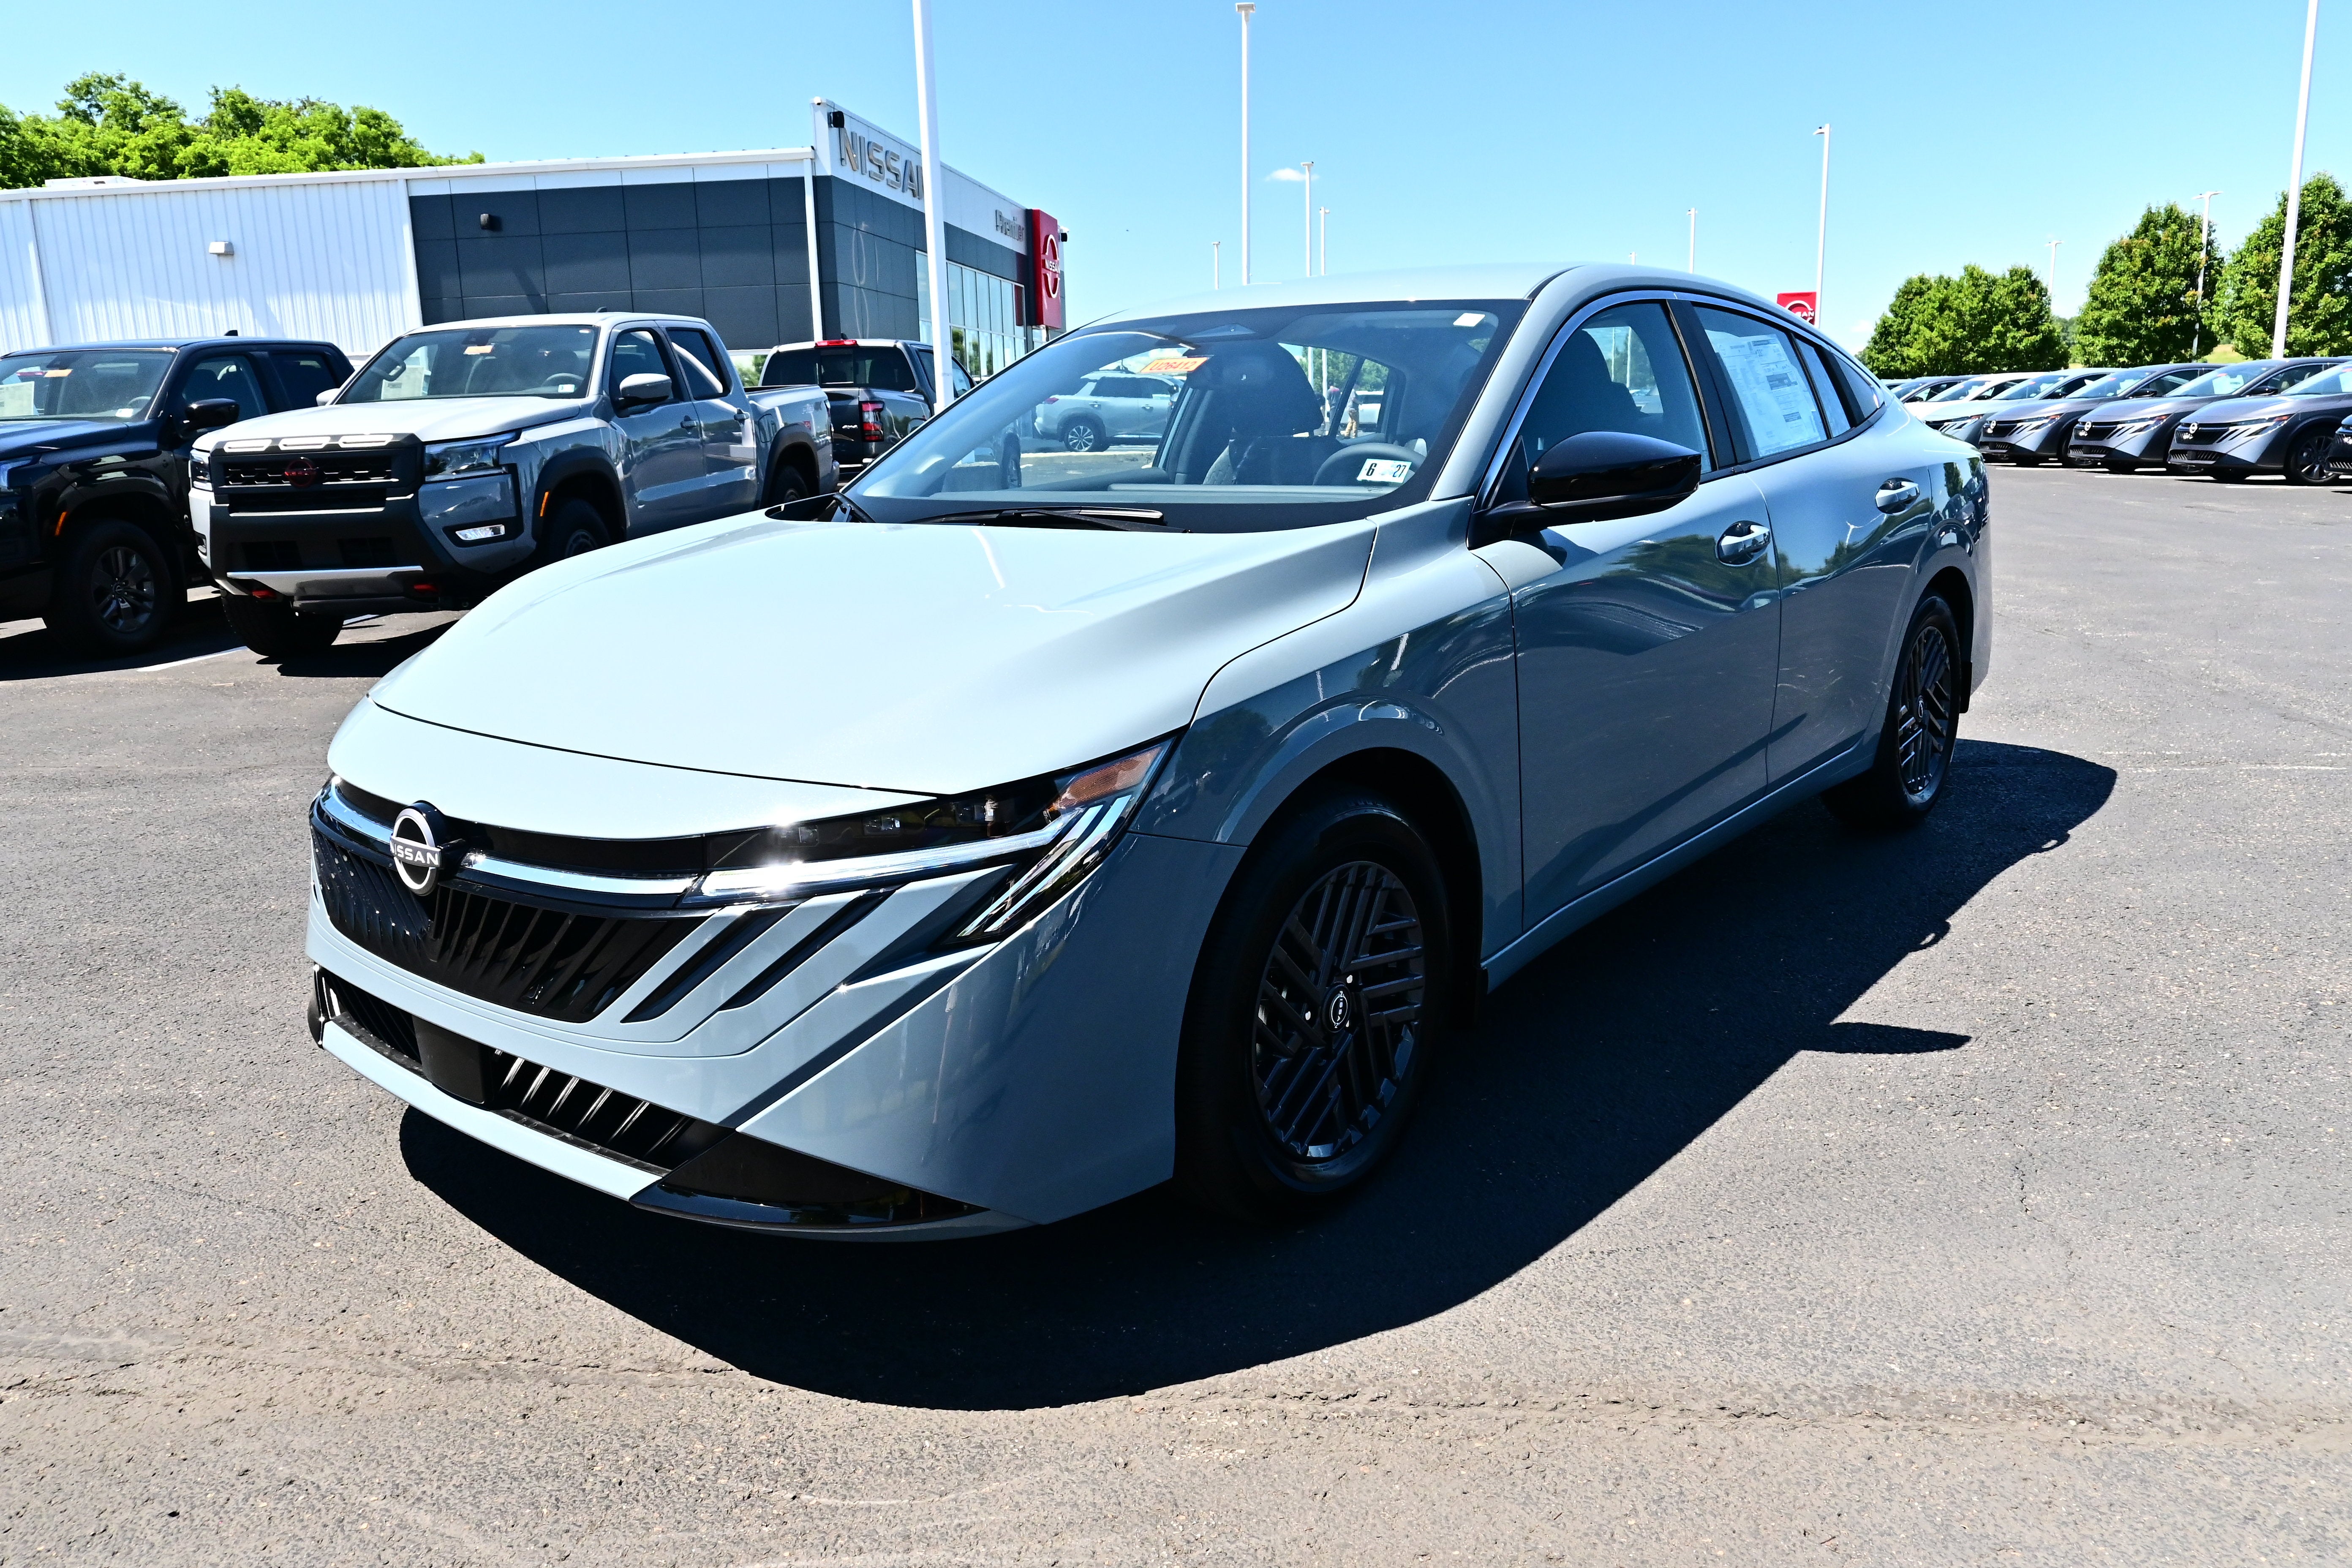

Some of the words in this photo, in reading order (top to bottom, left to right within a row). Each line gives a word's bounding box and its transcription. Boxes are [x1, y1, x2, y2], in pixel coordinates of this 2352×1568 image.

[1045, 258, 1060, 274] NISSAN
[1149, 361, 1197, 370] U26412
[1366, 463, 1377, 476] 6
[1392, 464, 1407, 478] 27
[390, 840, 438, 865] NISSAN
